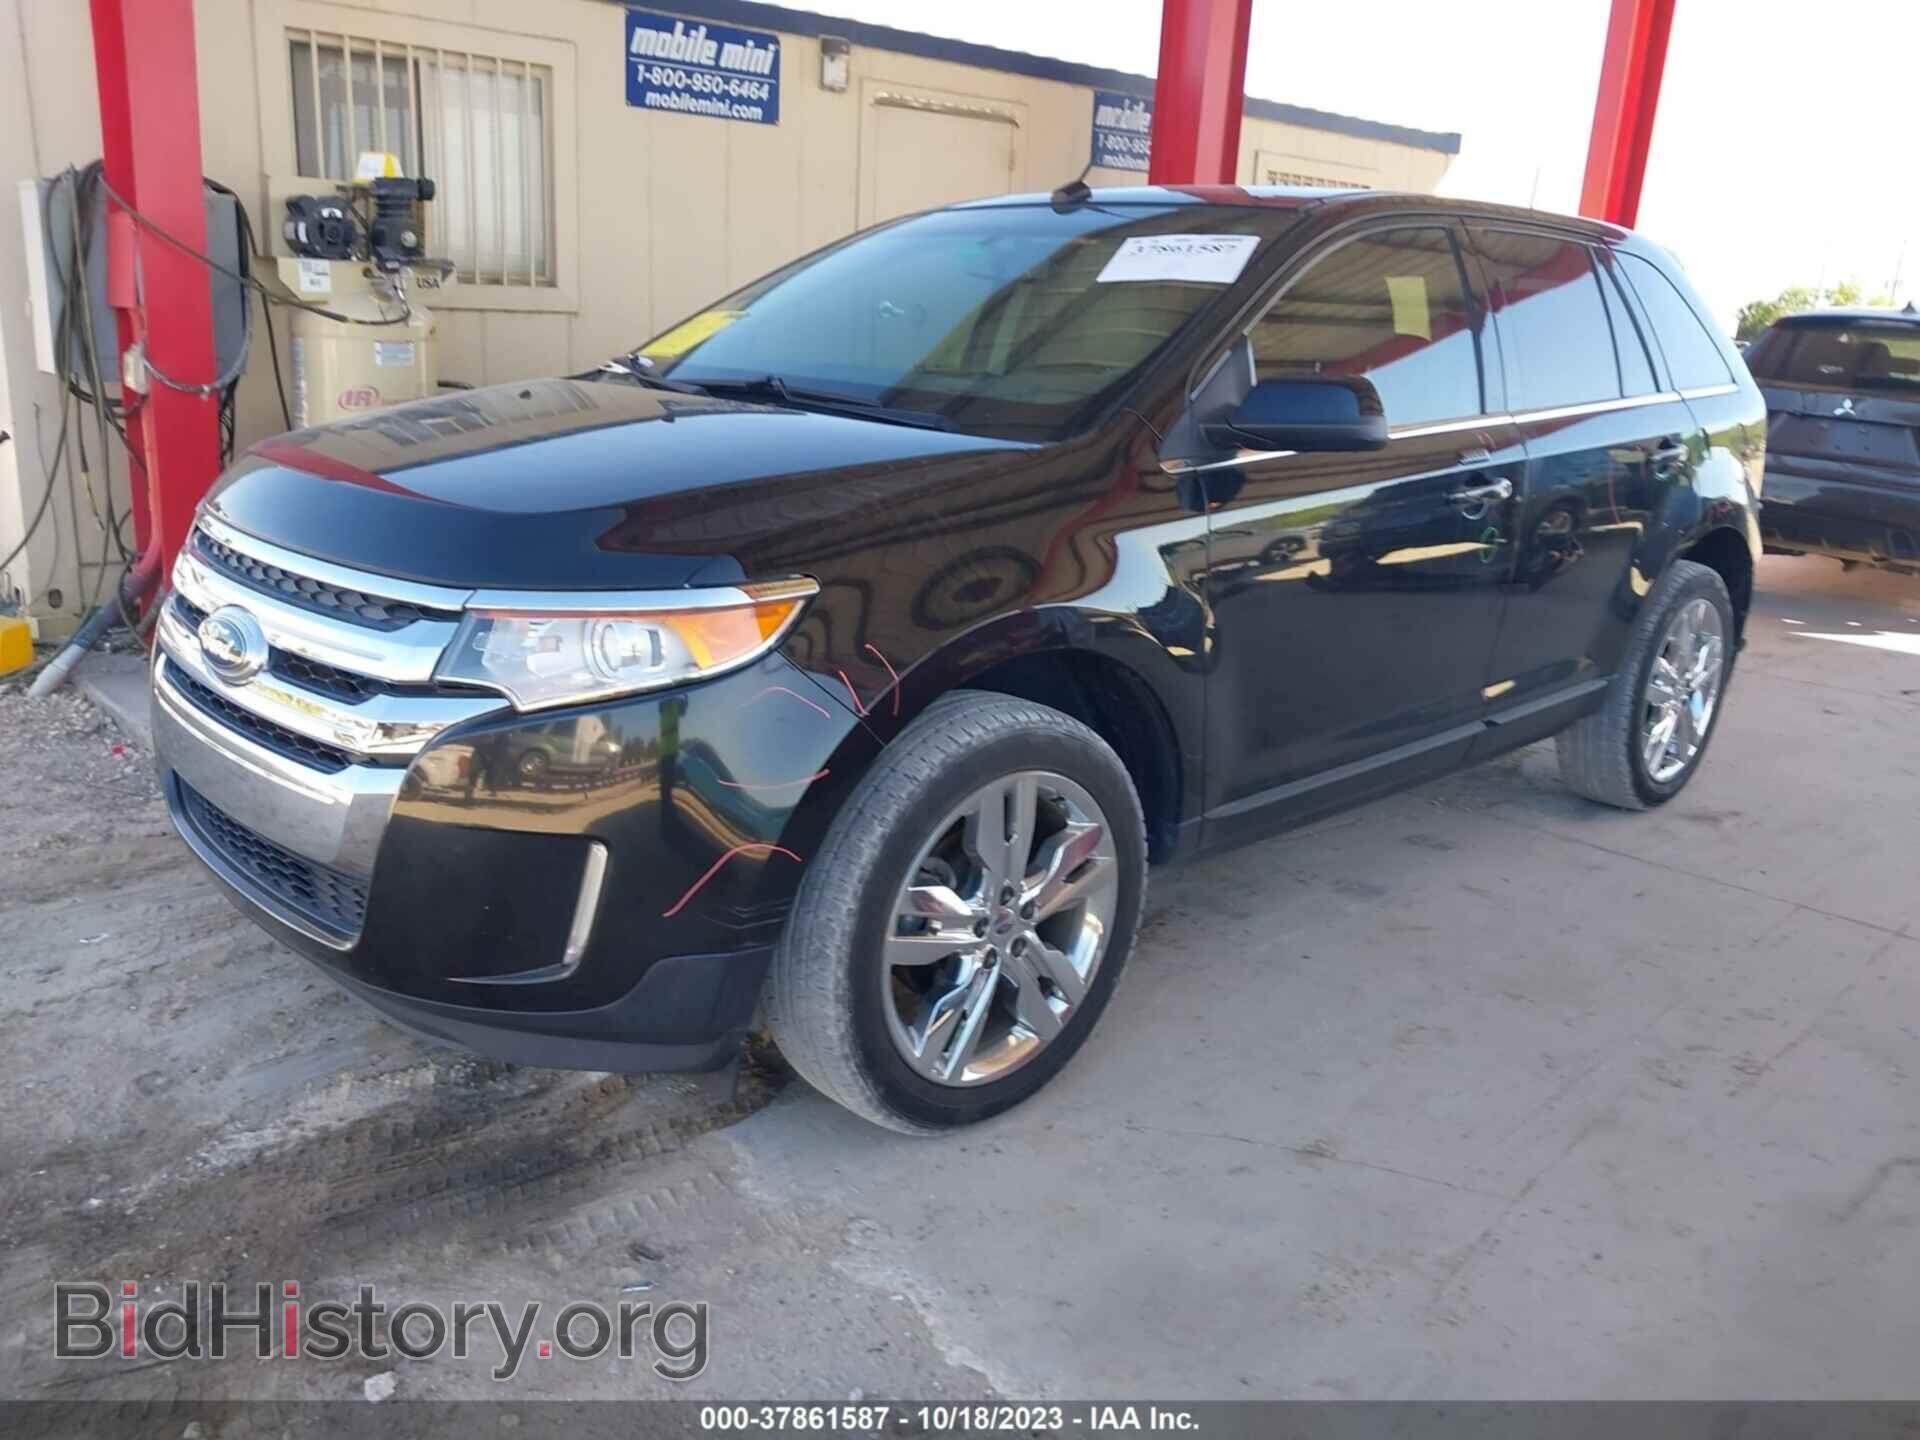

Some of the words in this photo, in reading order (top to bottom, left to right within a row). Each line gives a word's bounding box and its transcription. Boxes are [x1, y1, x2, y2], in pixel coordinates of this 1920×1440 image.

[631, 21, 718, 66] mobile
[719, 39, 776, 75] mini
[637, 64, 770, 101] 1-800-950-6464
[645, 91, 763, 121] mobilemini.com
[416, 276, 441, 290] USA
